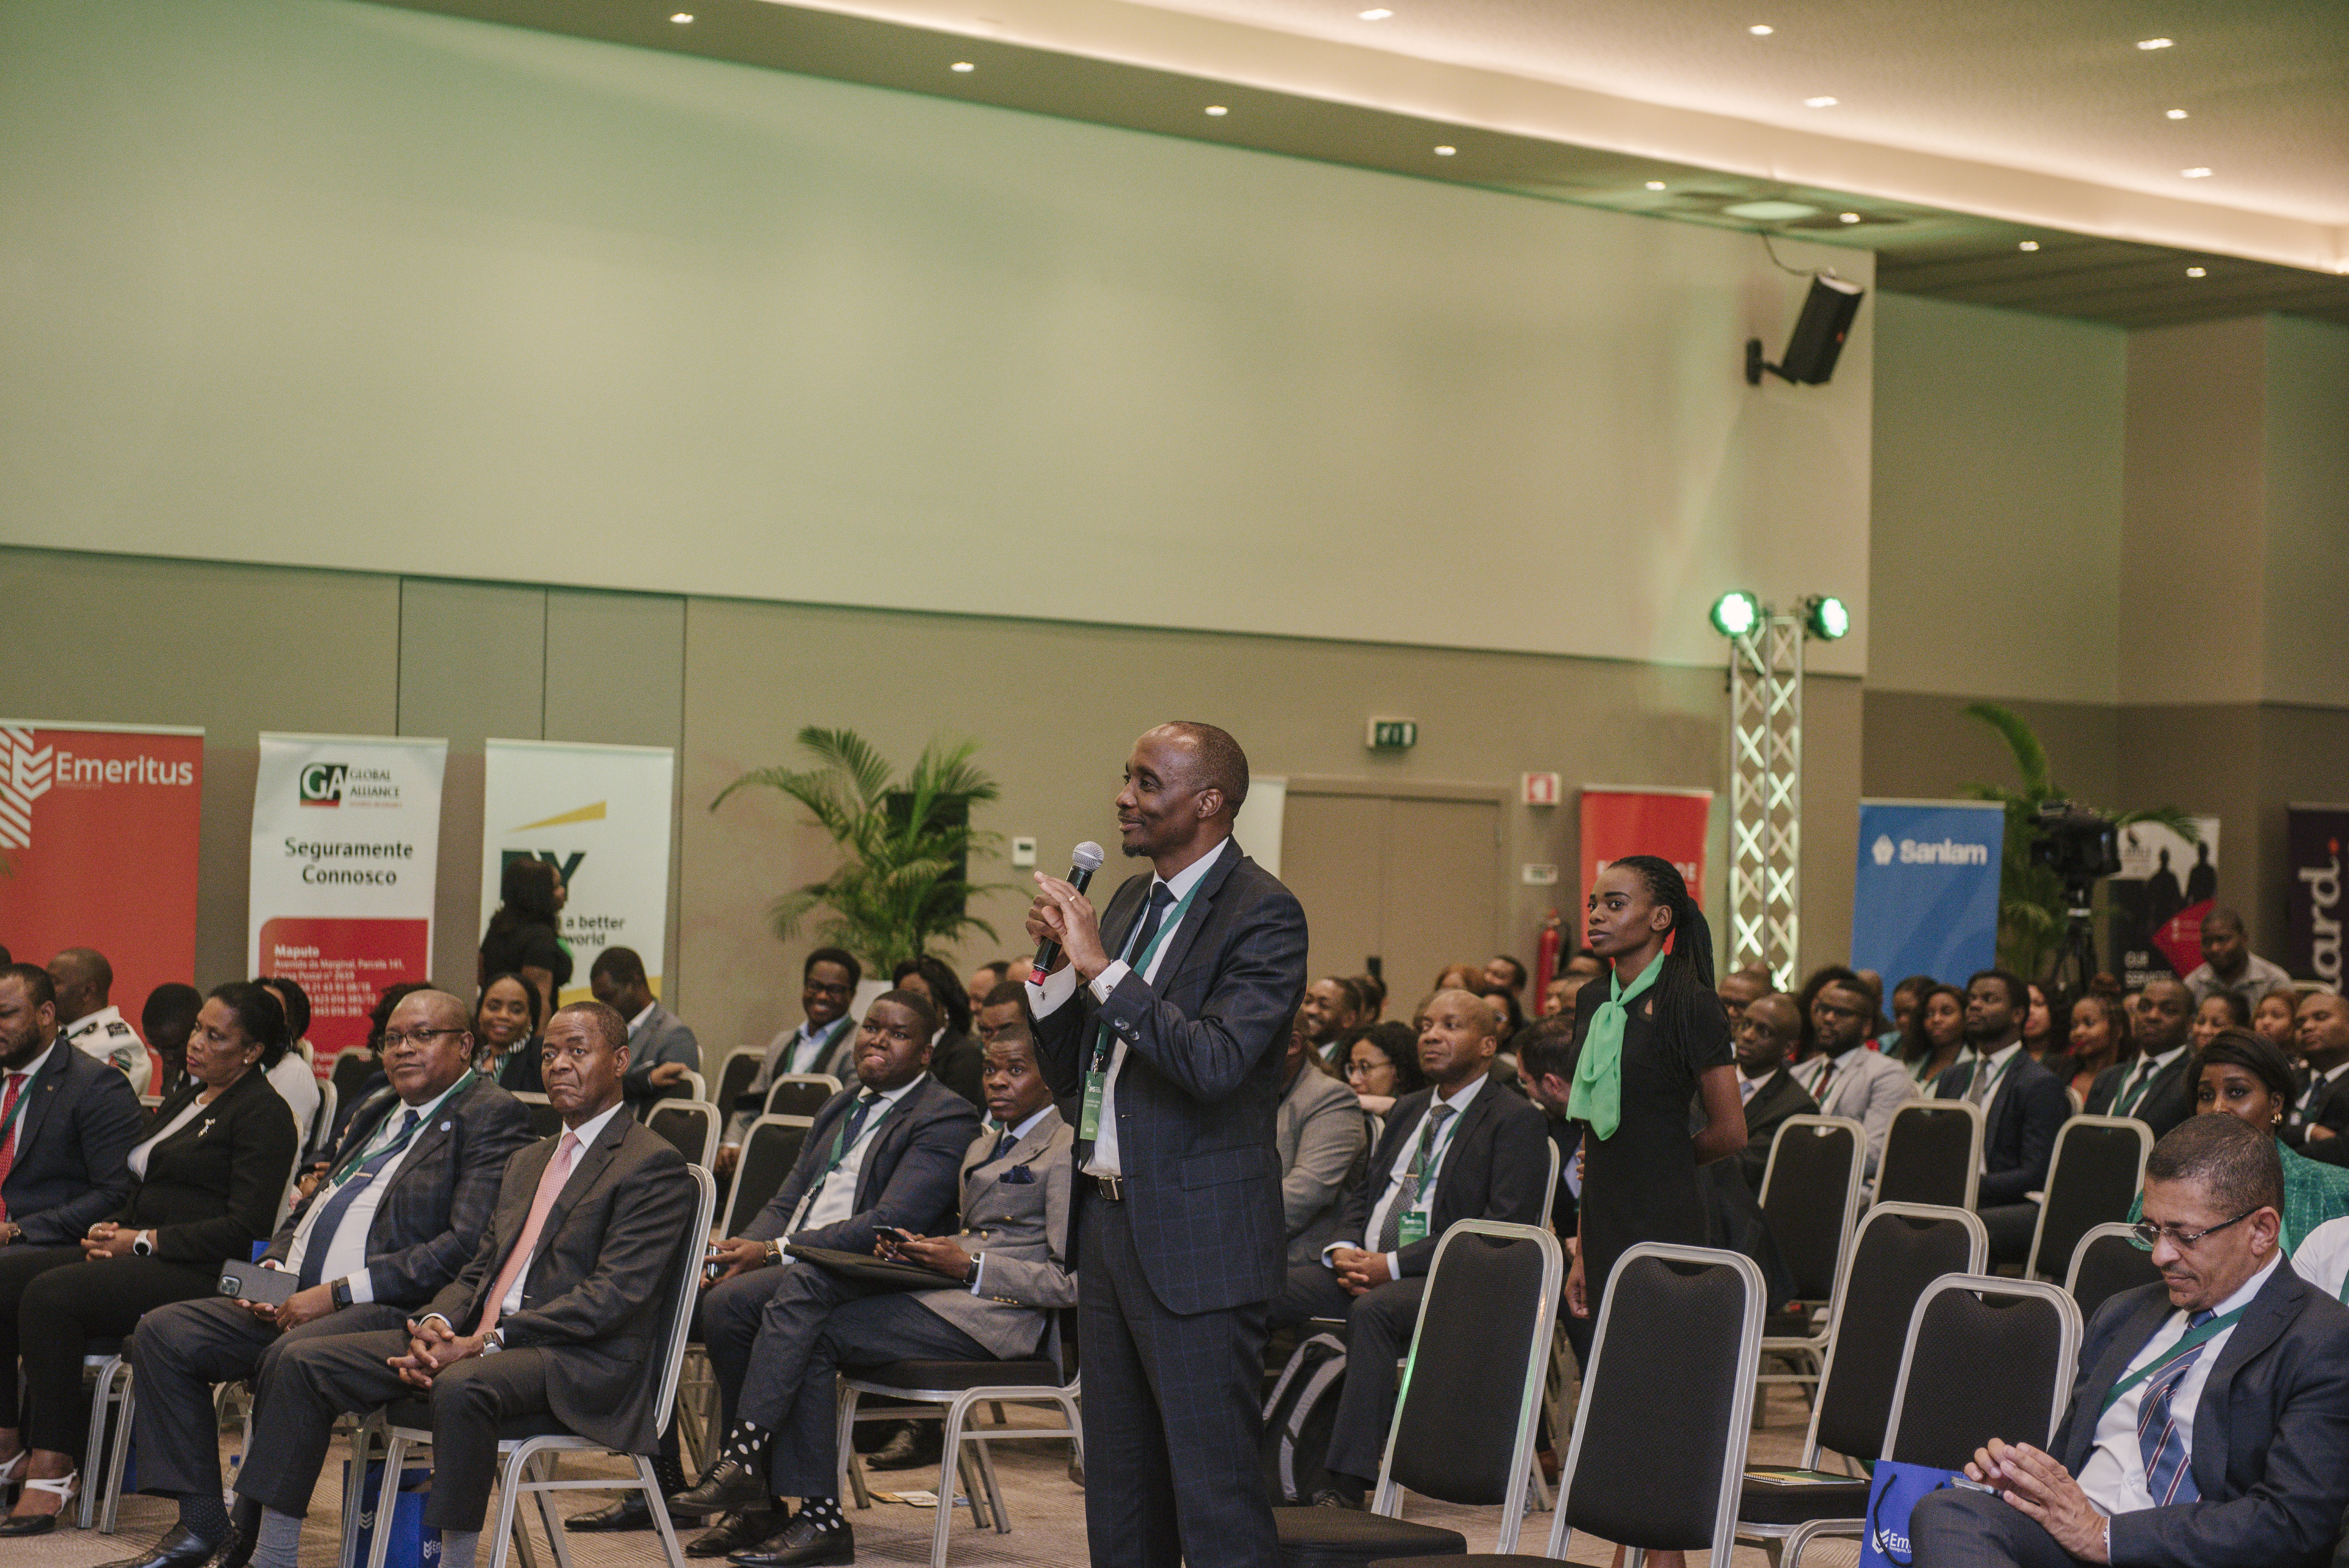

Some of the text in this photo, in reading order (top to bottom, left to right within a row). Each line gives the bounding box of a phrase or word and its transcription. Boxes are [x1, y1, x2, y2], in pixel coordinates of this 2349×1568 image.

[56, 751, 193, 786] Emeritus
[350, 768, 391, 780] GLOBAL
[301, 764, 346, 800] GA
[350, 785, 400, 797] ALLIANCE
[285, 837, 413, 862] Seguramente
[1899, 837, 1988, 866] Sanlam
[302, 864, 397, 886] Connosco
[566, 914, 626, 929] a better
[2298, 855, 2343, 994] ard
[566, 932, 605, 945] world
[274, 944, 320, 959] Maputo
[1890, 1532, 1911, 1549] Em
